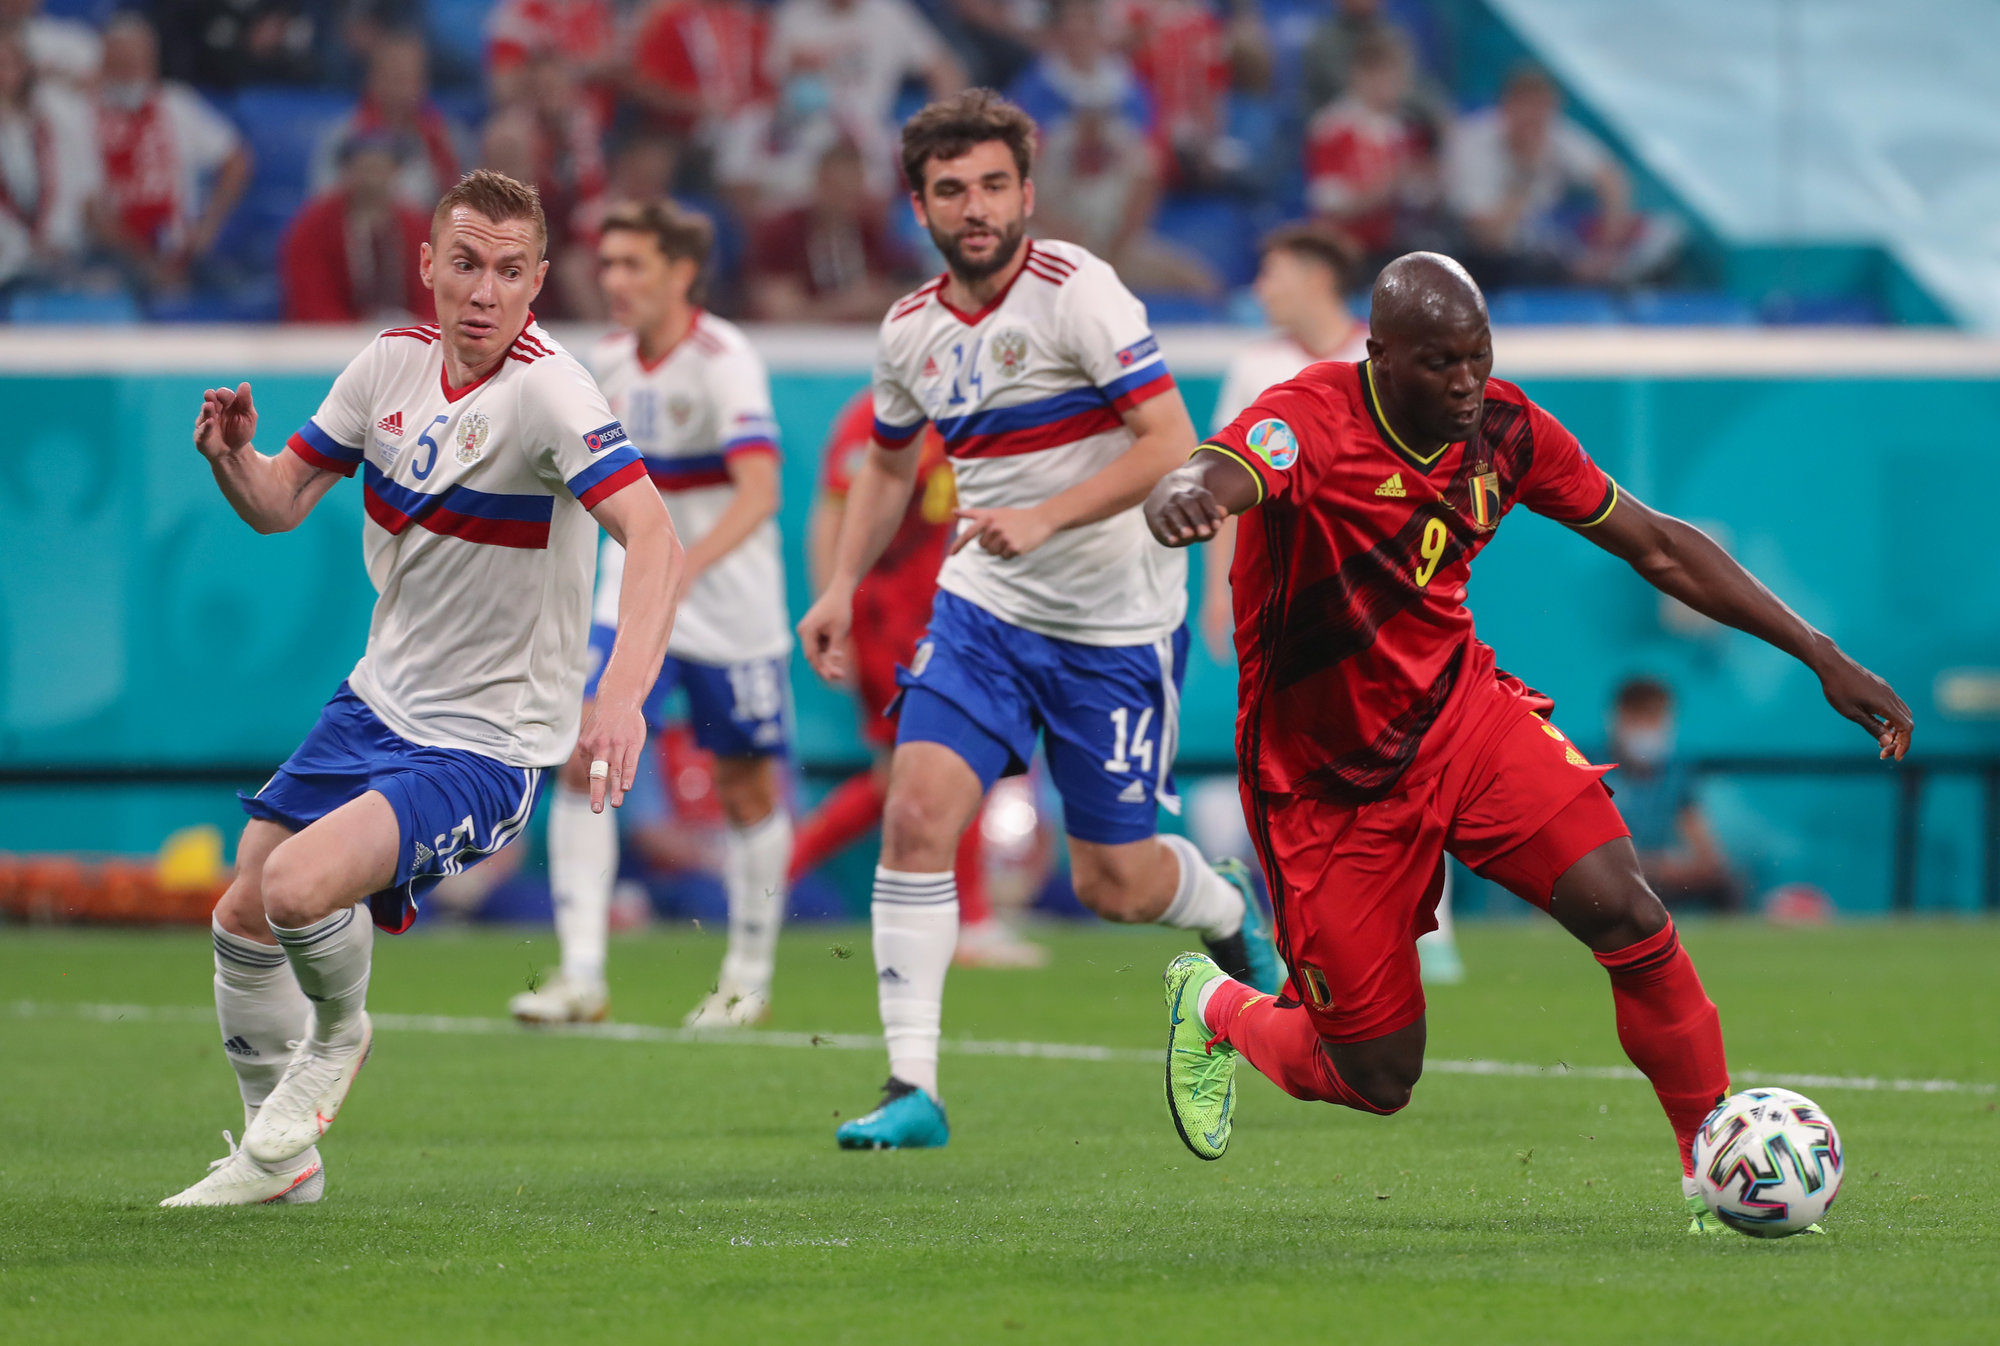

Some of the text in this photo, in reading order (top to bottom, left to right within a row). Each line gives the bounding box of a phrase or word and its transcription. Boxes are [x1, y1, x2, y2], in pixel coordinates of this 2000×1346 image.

[948, 339, 983, 405] 14
[376, 421, 404, 436] adidas
[411, 415, 449, 480] 5
[1374, 487, 1406, 497] adidas
[1415, 517, 1447, 587] 9
[1104, 707, 1154, 773] 14
[435, 814, 476, 856] 5
